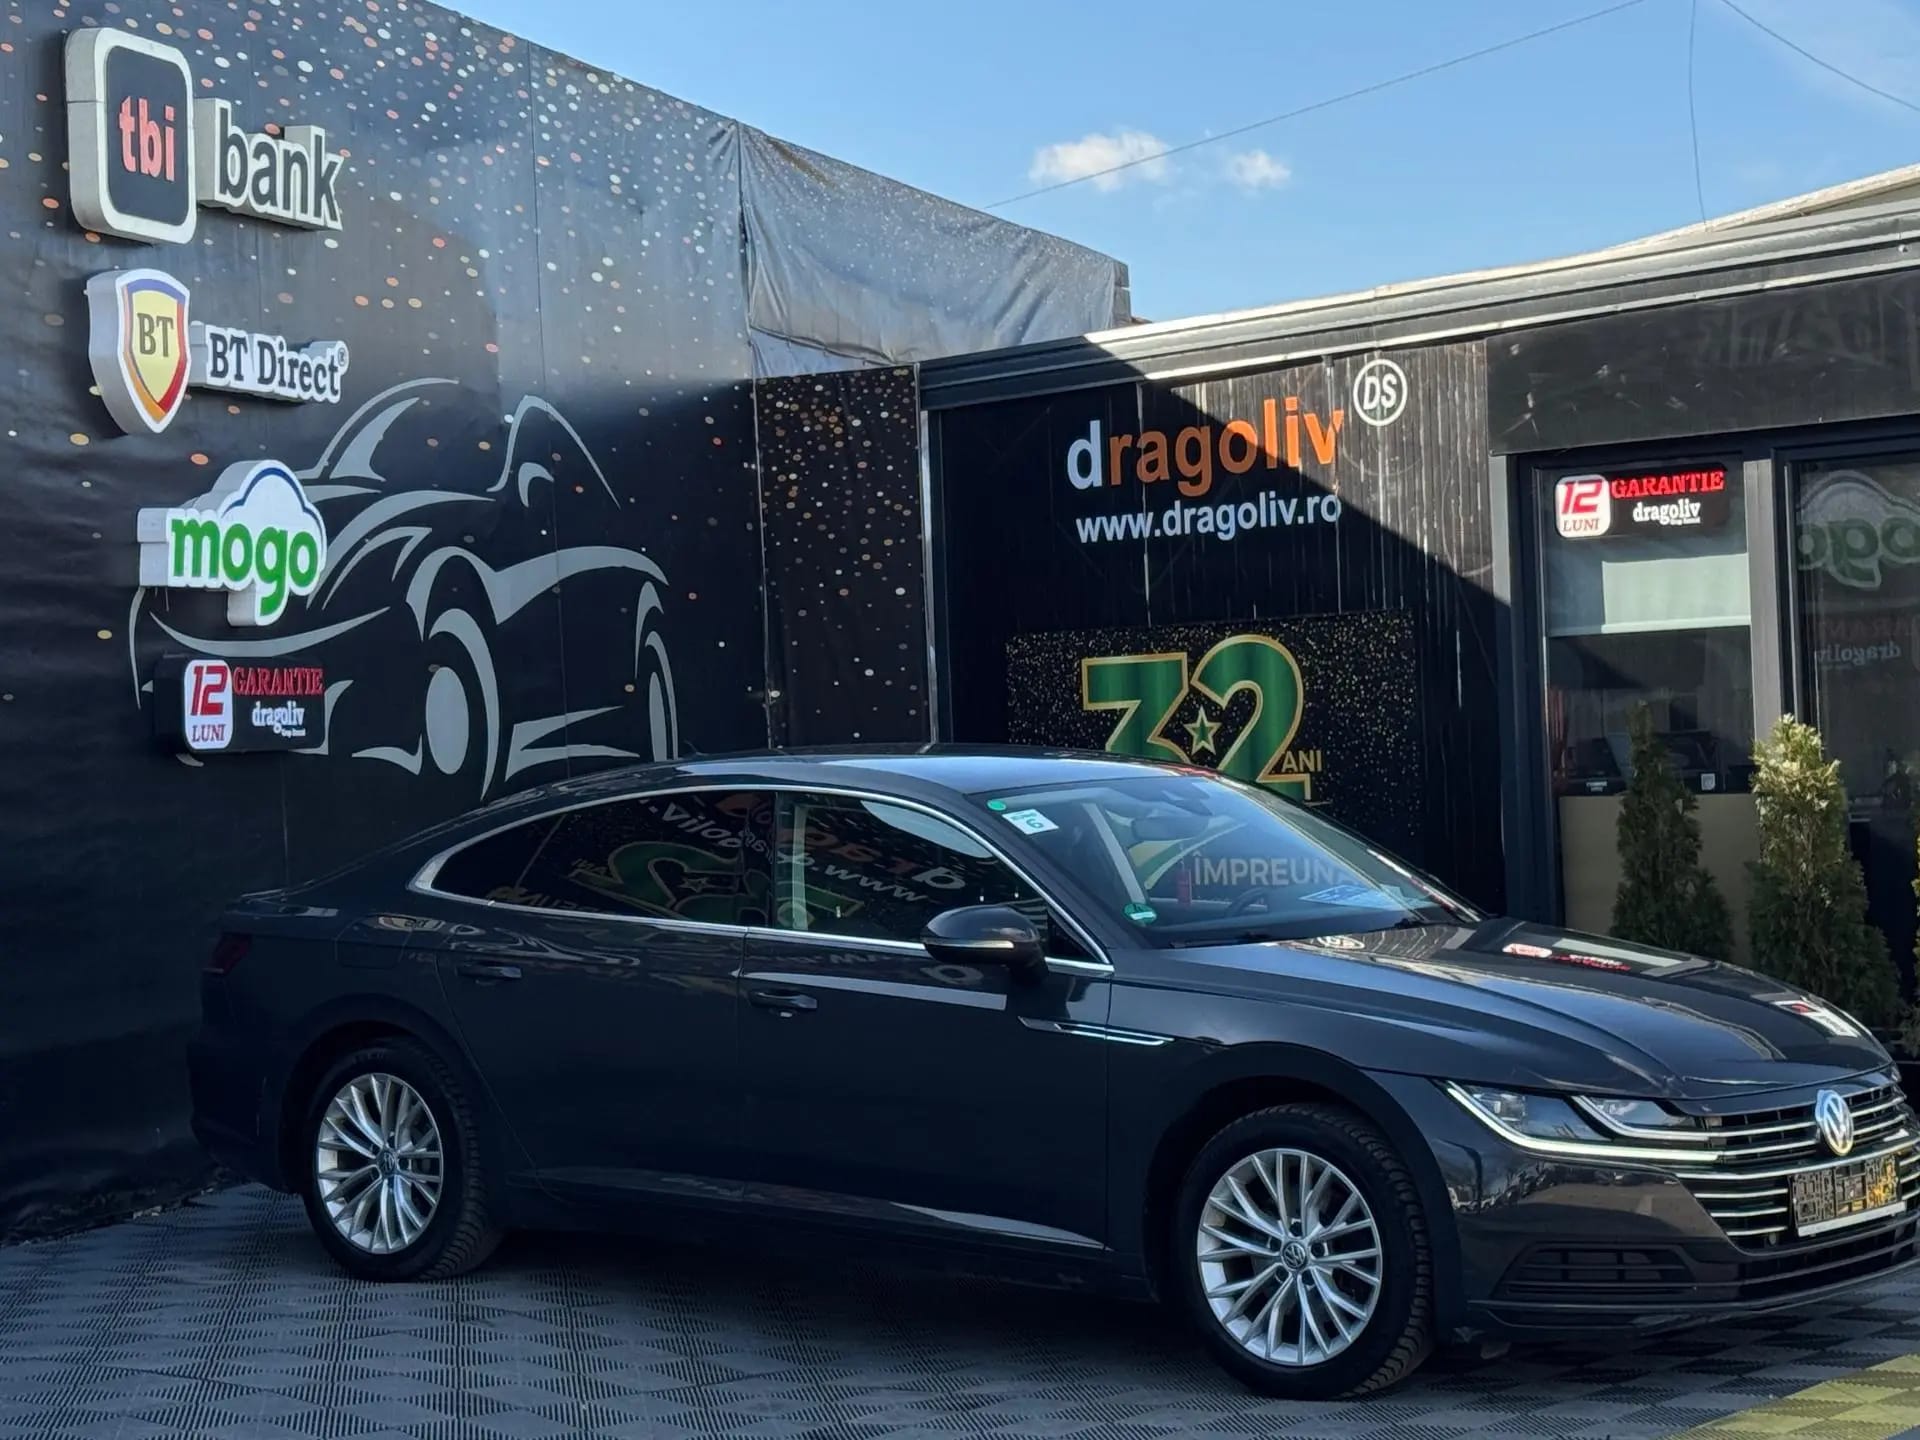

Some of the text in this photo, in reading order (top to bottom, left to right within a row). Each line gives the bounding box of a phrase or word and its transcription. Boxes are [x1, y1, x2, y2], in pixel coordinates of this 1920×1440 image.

[118, 95, 176, 183] tbi
[218, 106, 340, 223] bank
[137, 313, 174, 358] BT
[209, 333, 248, 382] BT
[1363, 373, 1397, 410] DS
[1066, 396, 1345, 497] dragoliv
[1560, 479, 1602, 516] 12
[1610, 470, 1725, 499] GARANTIE
[1075, 491, 1342, 544] www.dragoliv.ro
[1562, 518, 1601, 533] LUNI
[1632, 498, 1701, 526] dragoliv
[171, 517, 319, 617] mogo
[190, 665, 229, 716] 12
[231, 666, 324, 696] GARANTIE
[191, 723, 226, 743] LUNI
[252, 700, 305, 734] dragoliv
[1281, 749, 1323, 773] ANI
